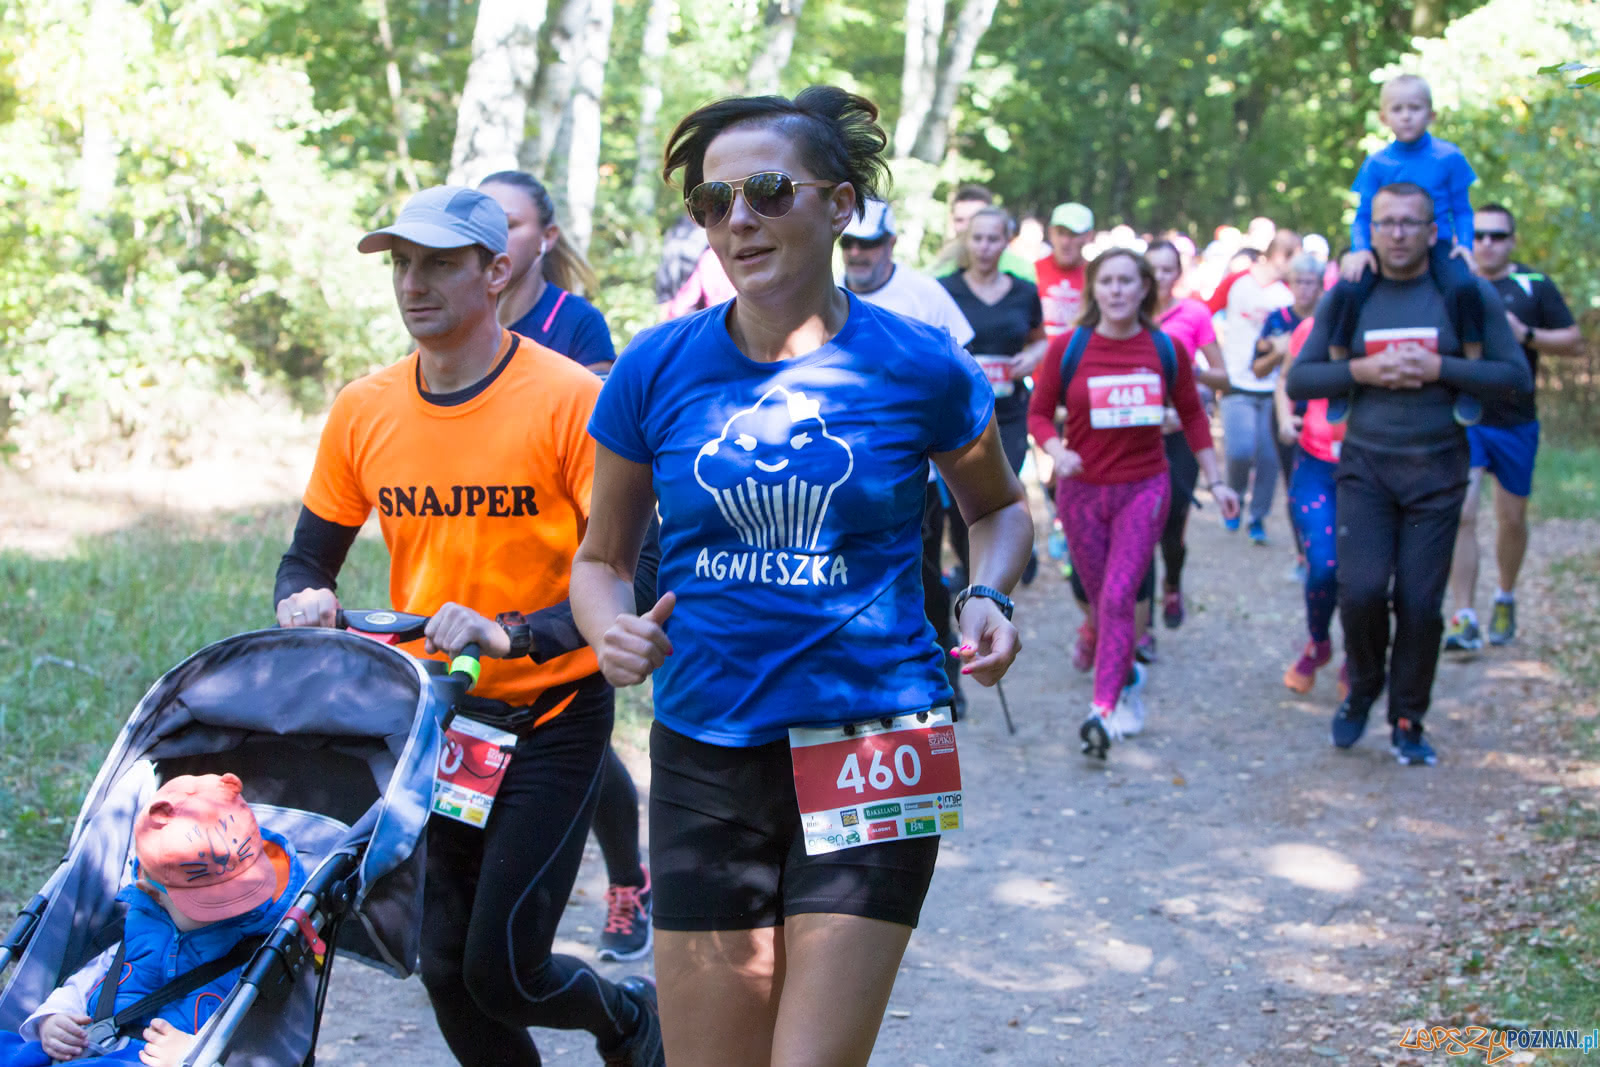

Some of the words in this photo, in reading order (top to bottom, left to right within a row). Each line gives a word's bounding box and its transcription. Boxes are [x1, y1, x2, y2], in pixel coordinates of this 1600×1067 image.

[1107, 386, 1146, 406] 468
[378, 485, 539, 517] SNAJPER
[695, 547, 848, 586] AGNIESZKA
[836, 744, 922, 794] 460
